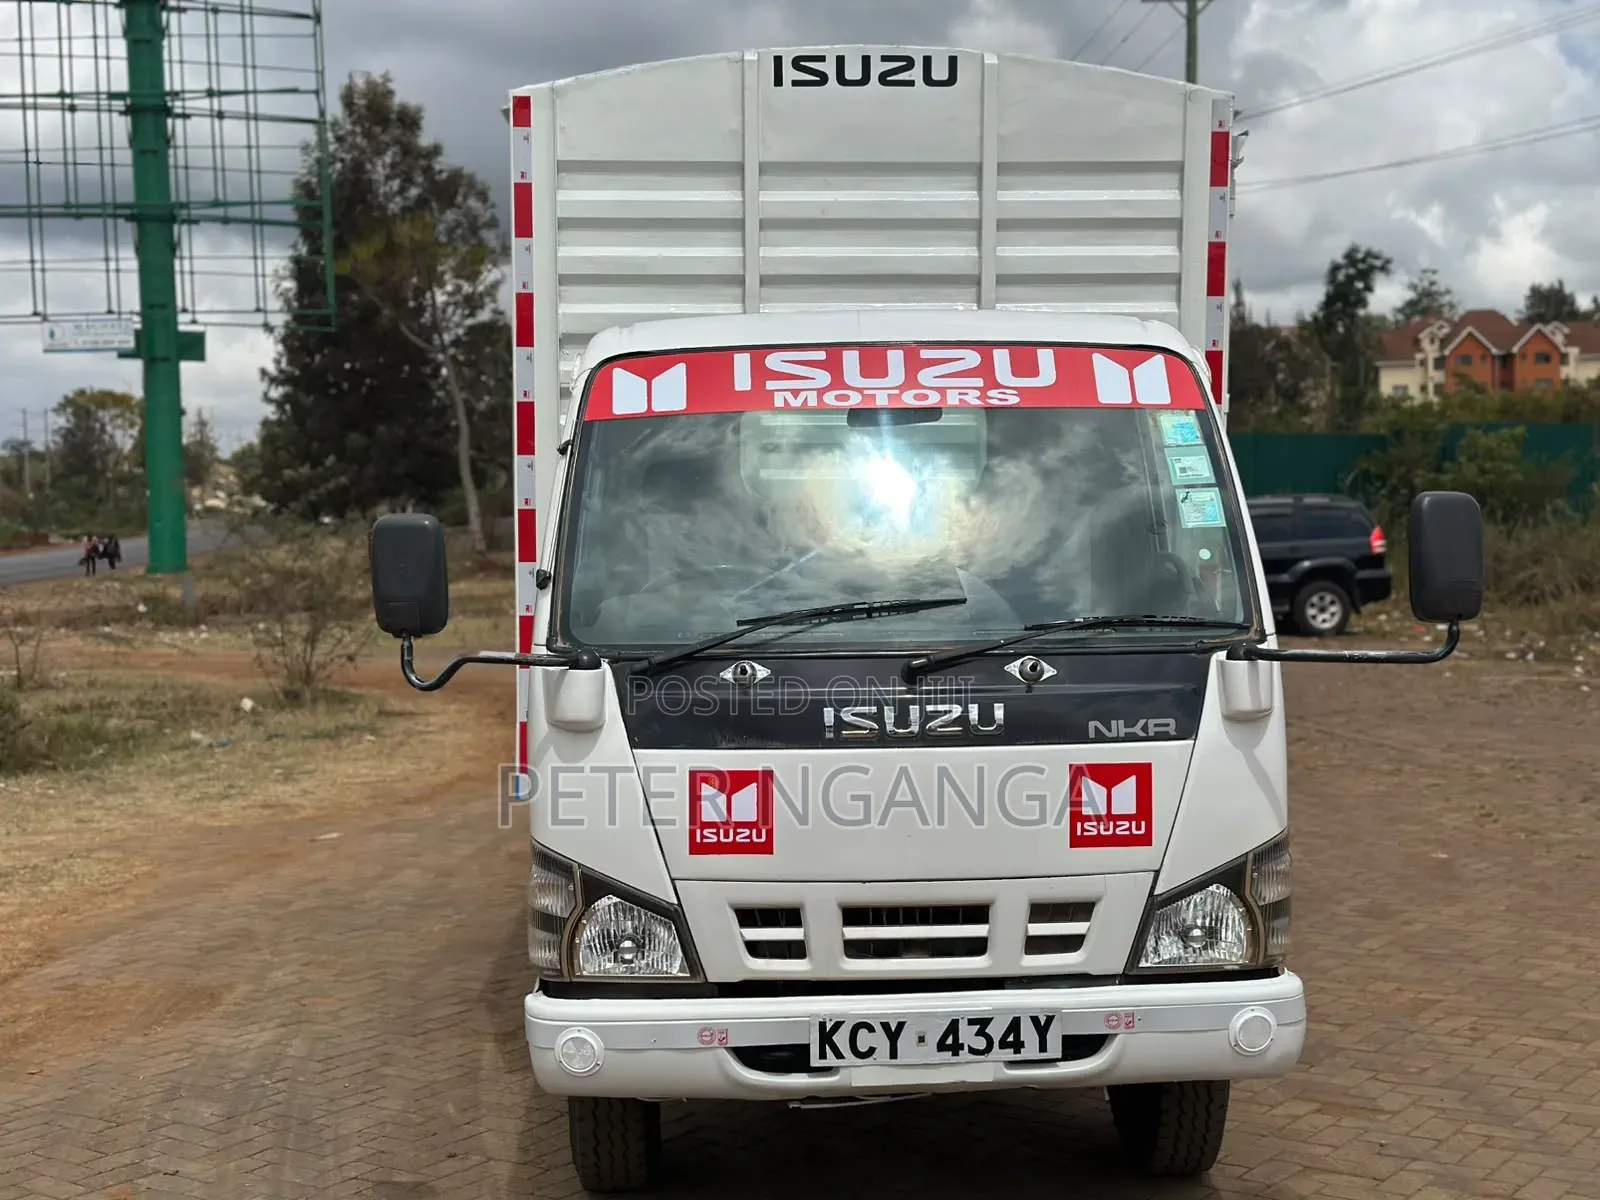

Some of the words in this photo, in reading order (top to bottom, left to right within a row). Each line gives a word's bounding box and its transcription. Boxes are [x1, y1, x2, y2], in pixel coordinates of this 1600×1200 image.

[773, 54, 958, 88] ISUZU
[733, 348, 1057, 391] ISUZU
[773, 388, 1021, 408] MOTORS
[823, 702, 1005, 741] ISUZU
[1087, 717, 1178, 739] NKR
[695, 828, 767, 843] ISUZU
[1076, 820, 1146, 836] ISUZU
[818, 1019, 908, 1061] KCY
[935, 1014, 1057, 1057] 434Y
